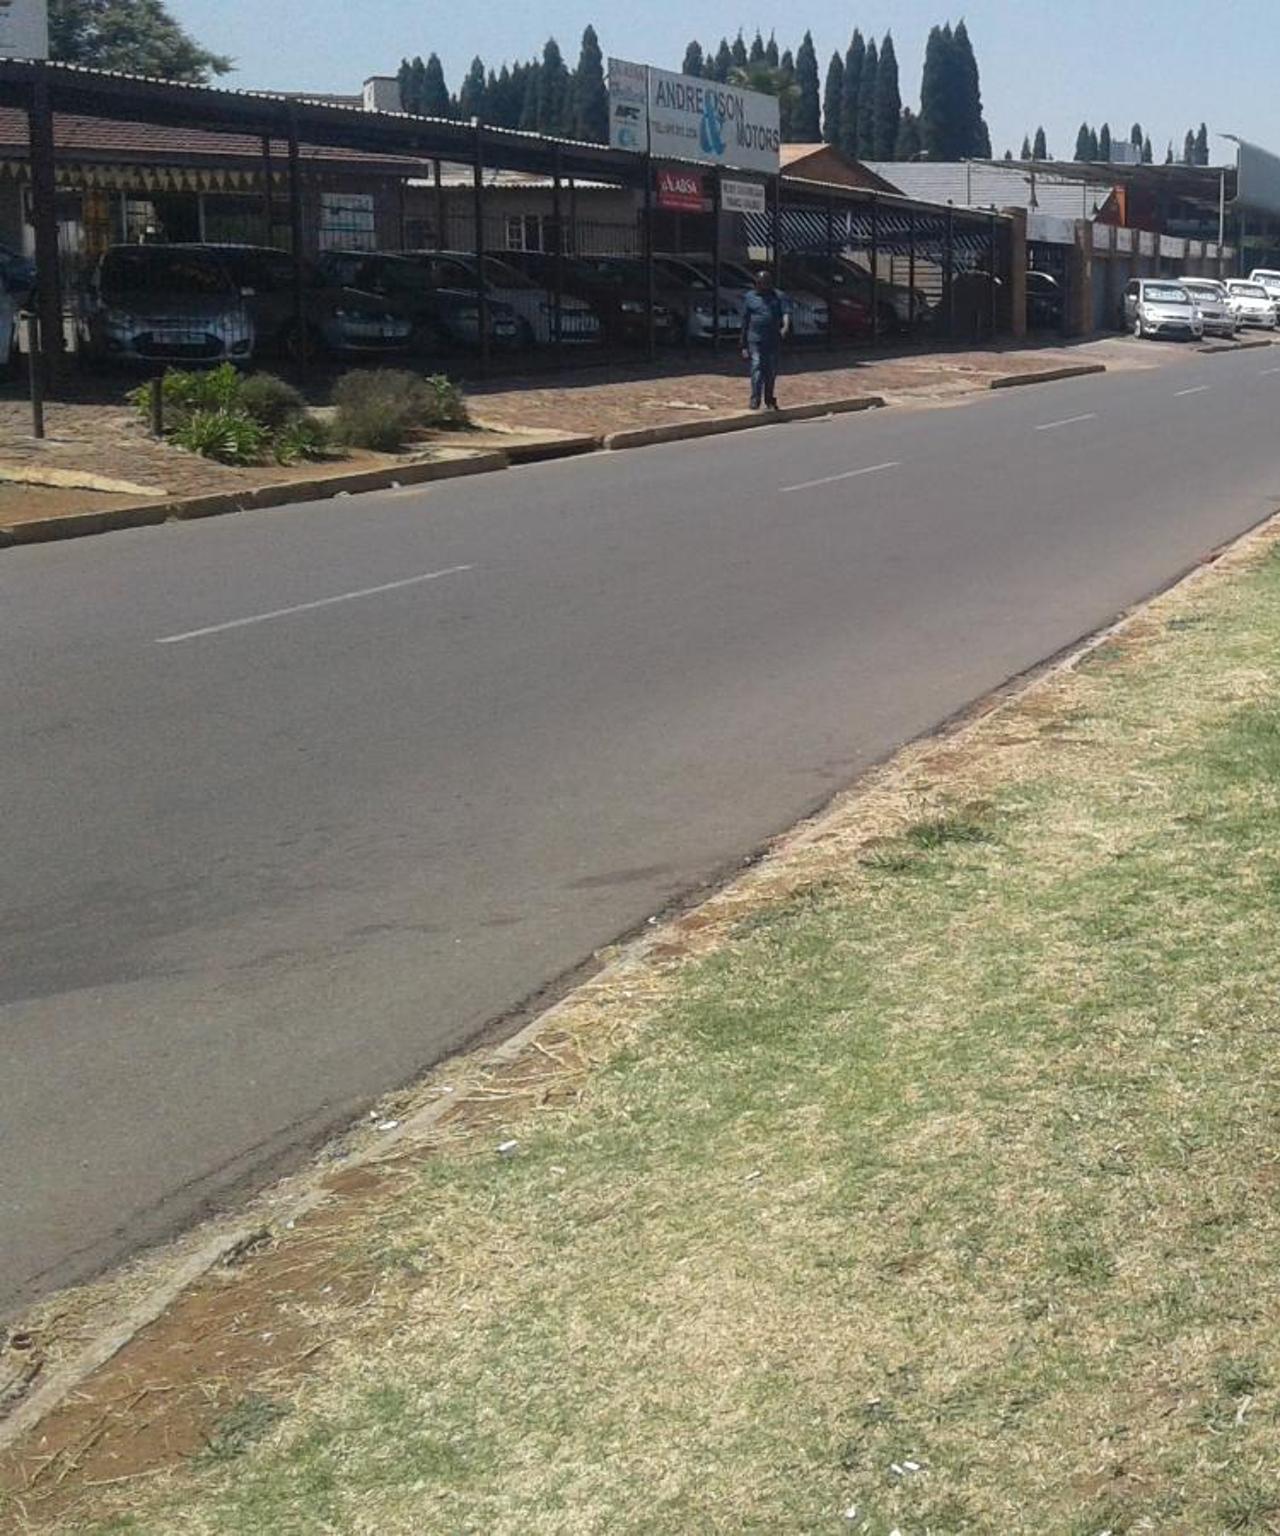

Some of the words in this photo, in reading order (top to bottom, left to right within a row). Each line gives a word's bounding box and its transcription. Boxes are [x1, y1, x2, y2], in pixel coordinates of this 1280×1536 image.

[656, 80, 703, 114] ANDRE
[701, 87, 726, 155] &
[718, 91, 744, 121] SON
[736, 121, 779, 151] MOTORS
